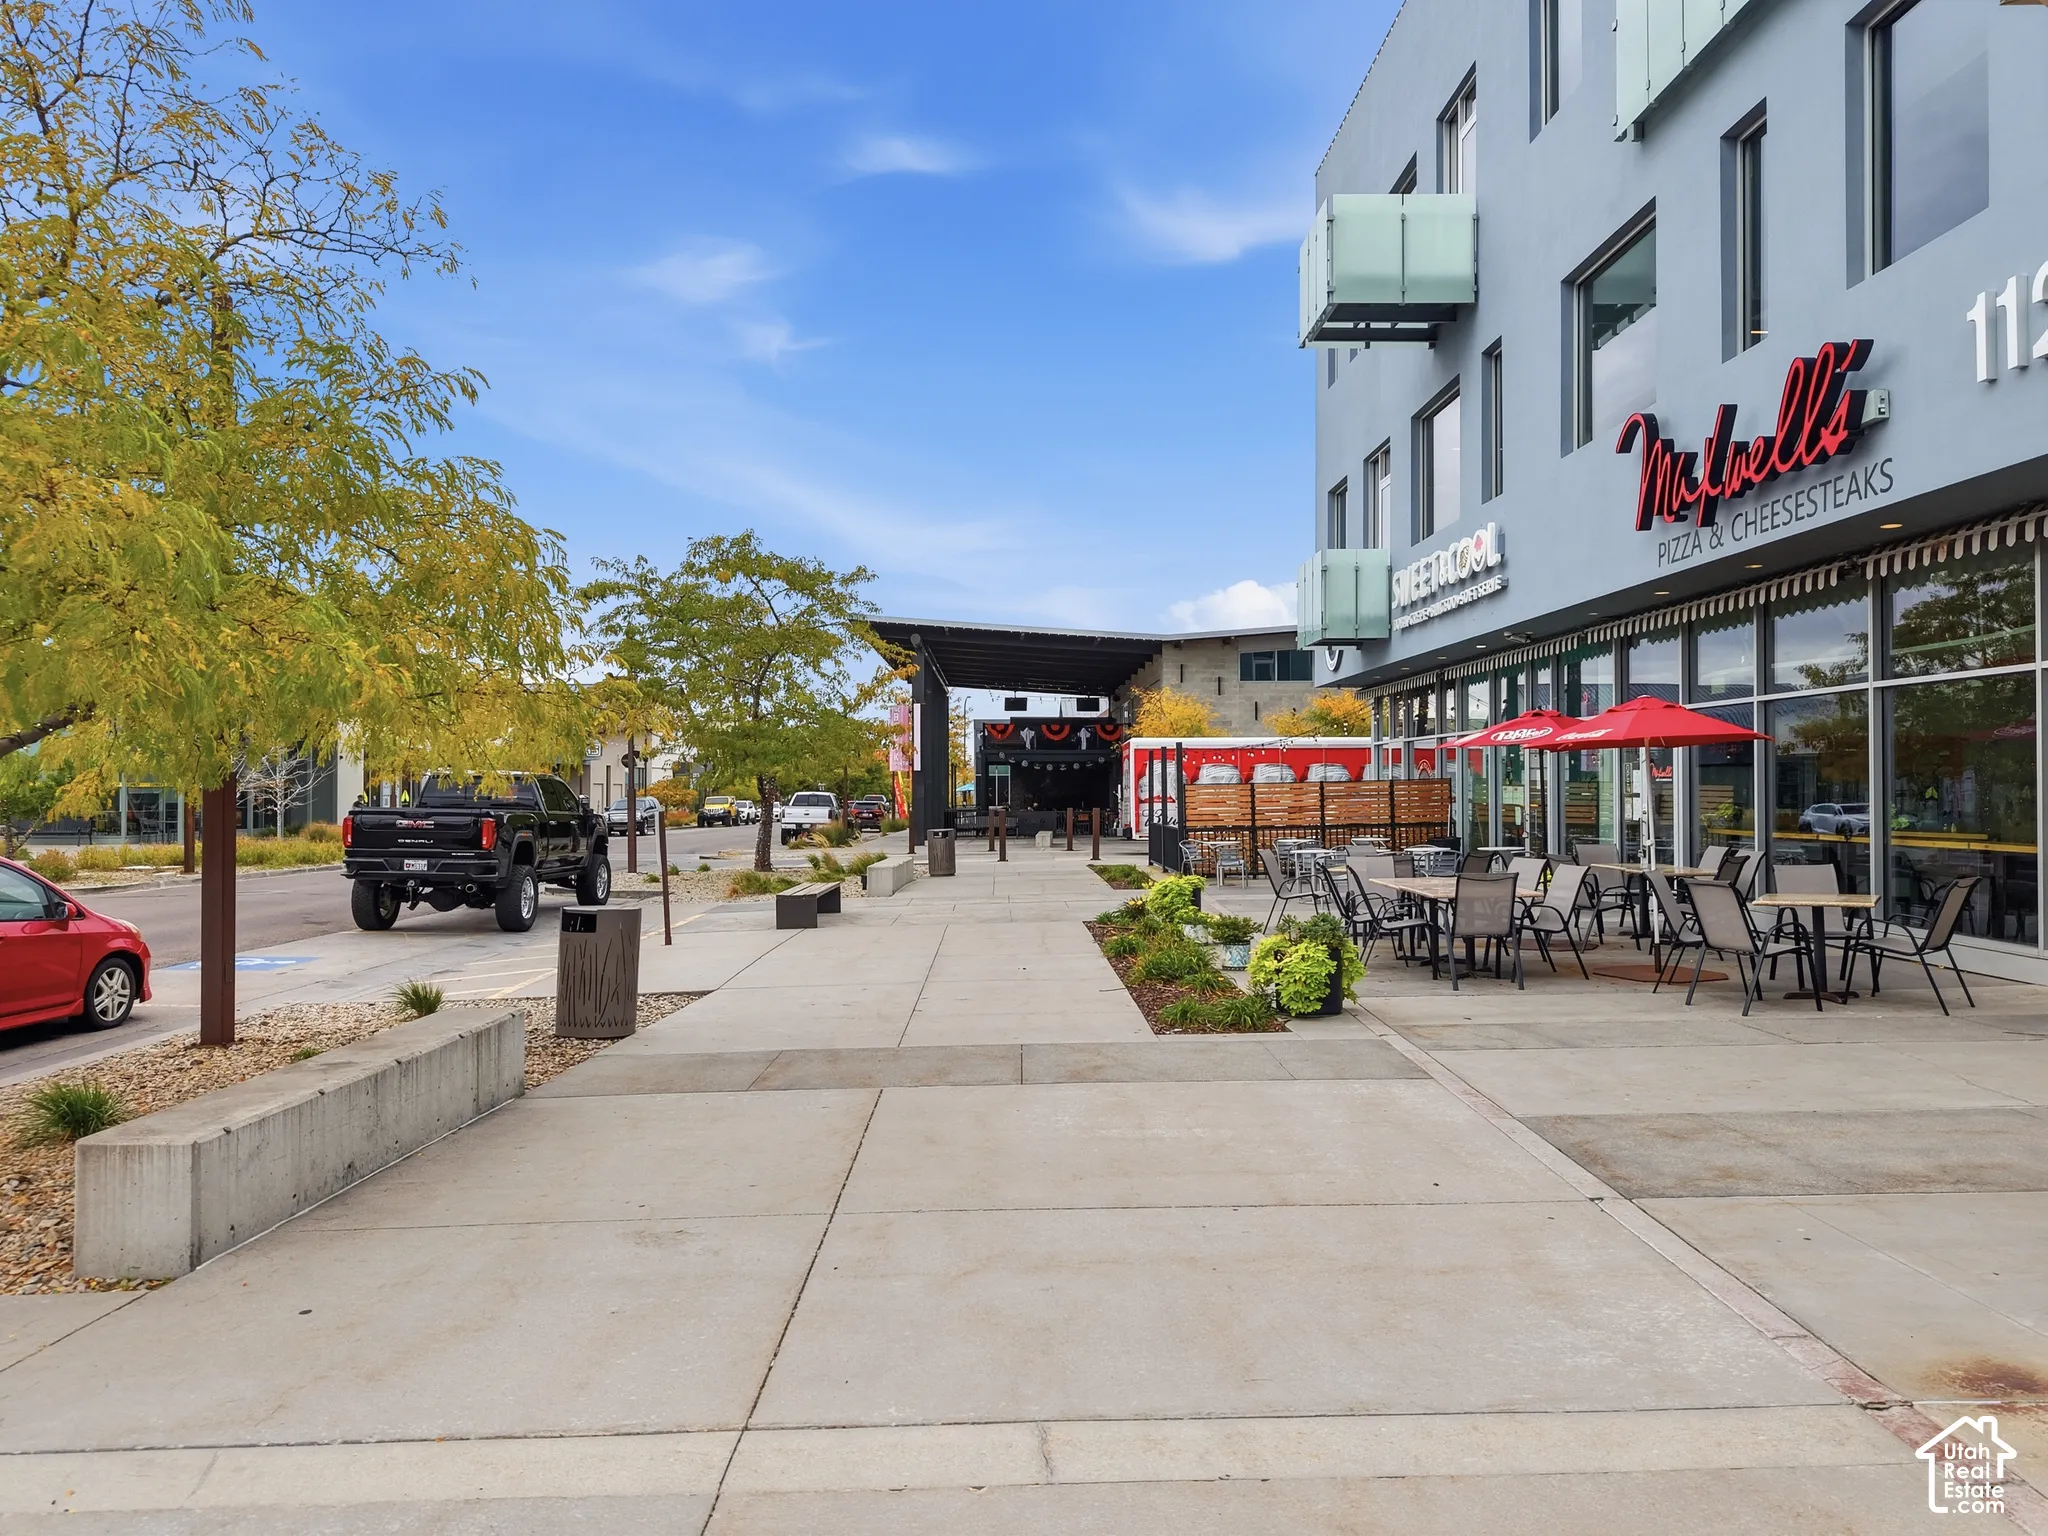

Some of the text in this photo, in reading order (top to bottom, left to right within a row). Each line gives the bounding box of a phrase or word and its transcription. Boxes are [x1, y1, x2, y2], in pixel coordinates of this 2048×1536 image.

[1616, 338, 1874, 531] Maxwell's
[1657, 457, 1894, 568] PIZZA & CHEESESTEAKS
[395, 819, 435, 828] GMC
